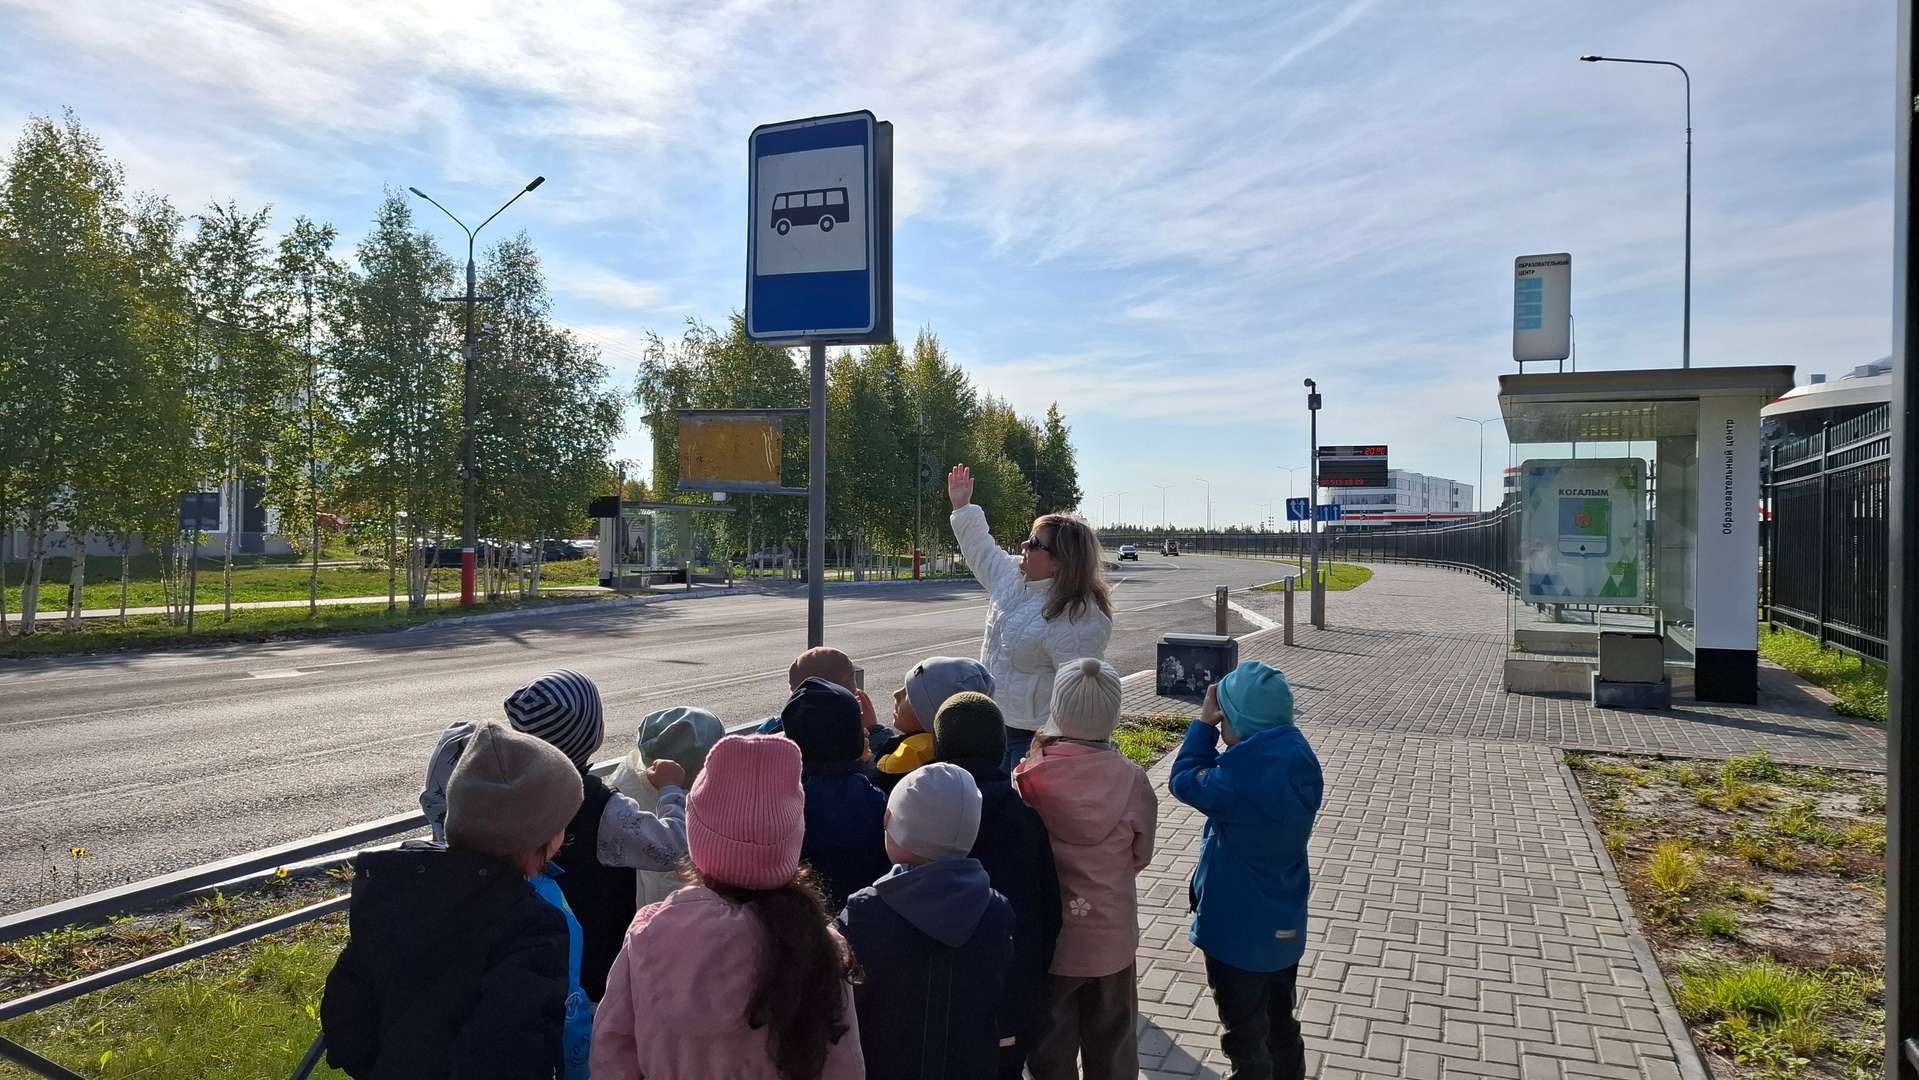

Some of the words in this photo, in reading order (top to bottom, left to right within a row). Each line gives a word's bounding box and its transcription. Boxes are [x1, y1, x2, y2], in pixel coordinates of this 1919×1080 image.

[1726, 419, 1735, 447] центр
[1558, 489, 1609, 497] КОГАЛЫМ
[1722, 450, 1734, 535] Образовательный
